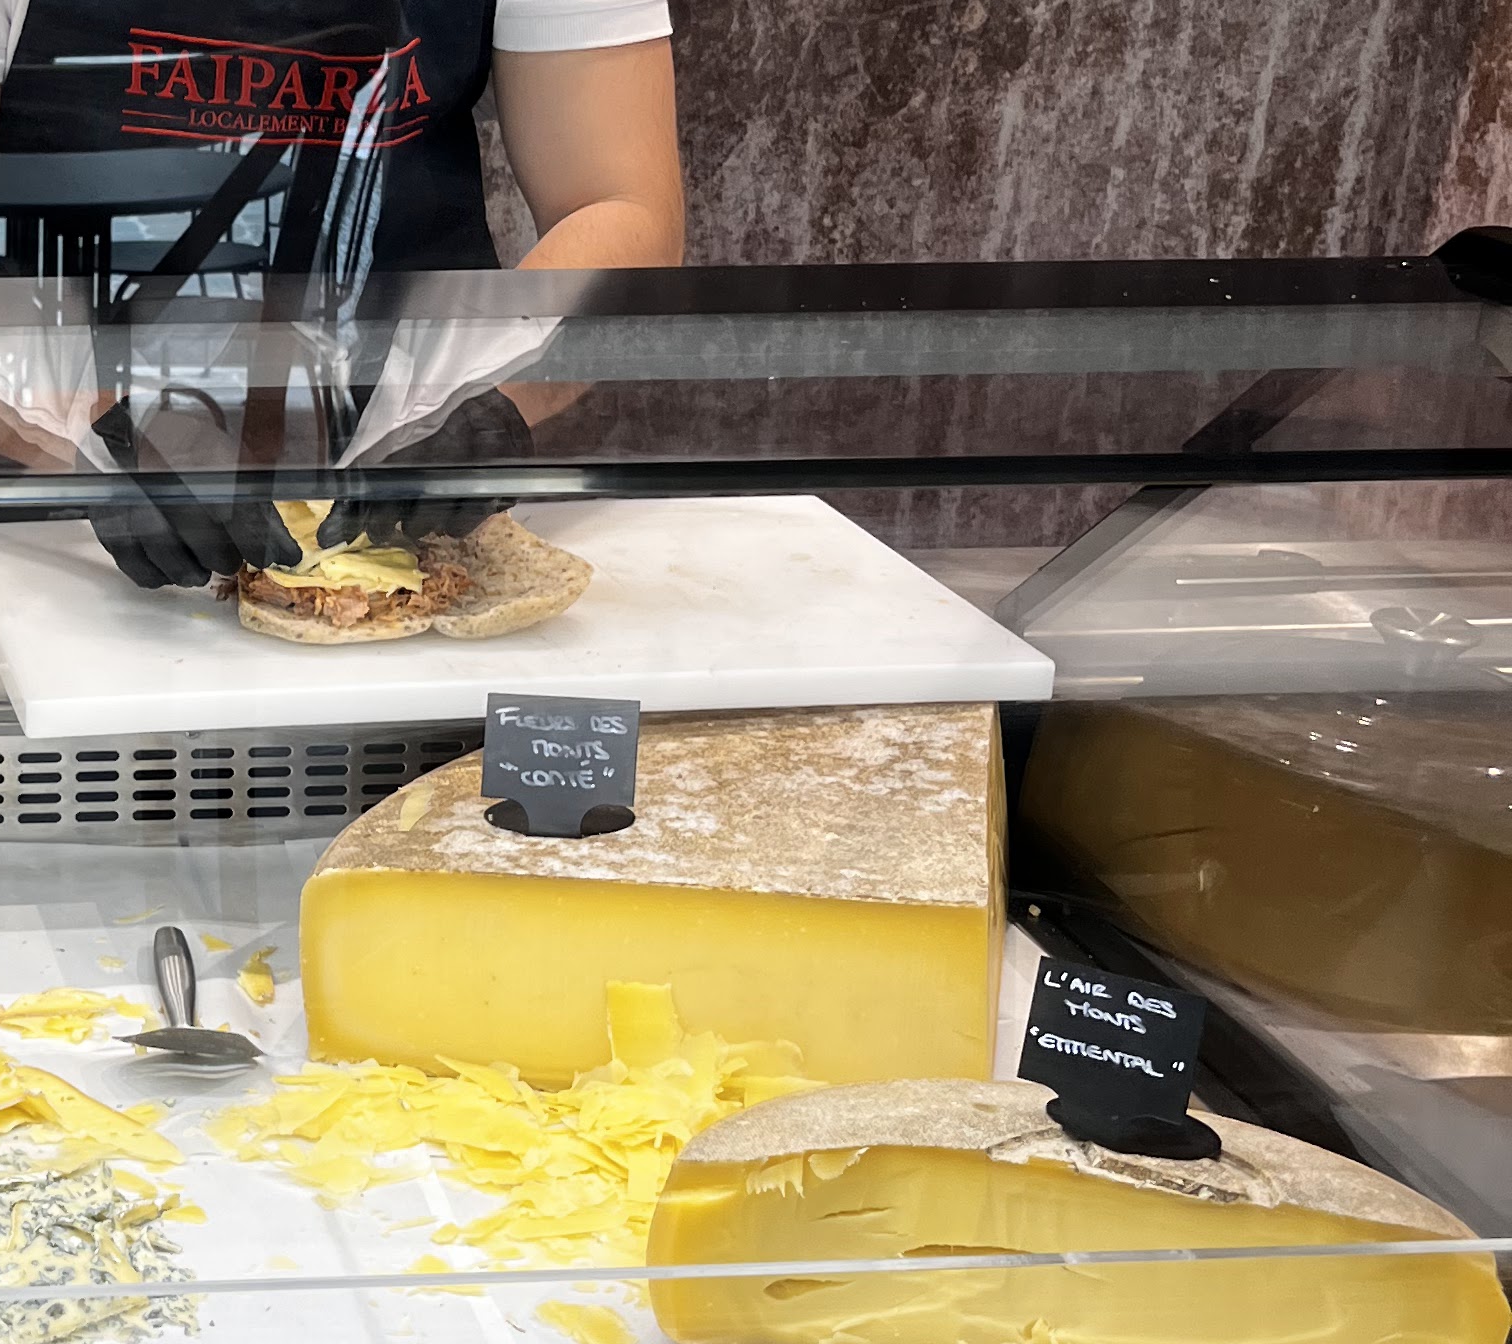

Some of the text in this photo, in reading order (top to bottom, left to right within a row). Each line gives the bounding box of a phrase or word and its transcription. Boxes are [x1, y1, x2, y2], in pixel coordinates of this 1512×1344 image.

[188, 108, 330, 134] LOCALEMENT
[590, 715, 628, 734] DES
[1044, 970, 1177, 1019] L'AIR DES
